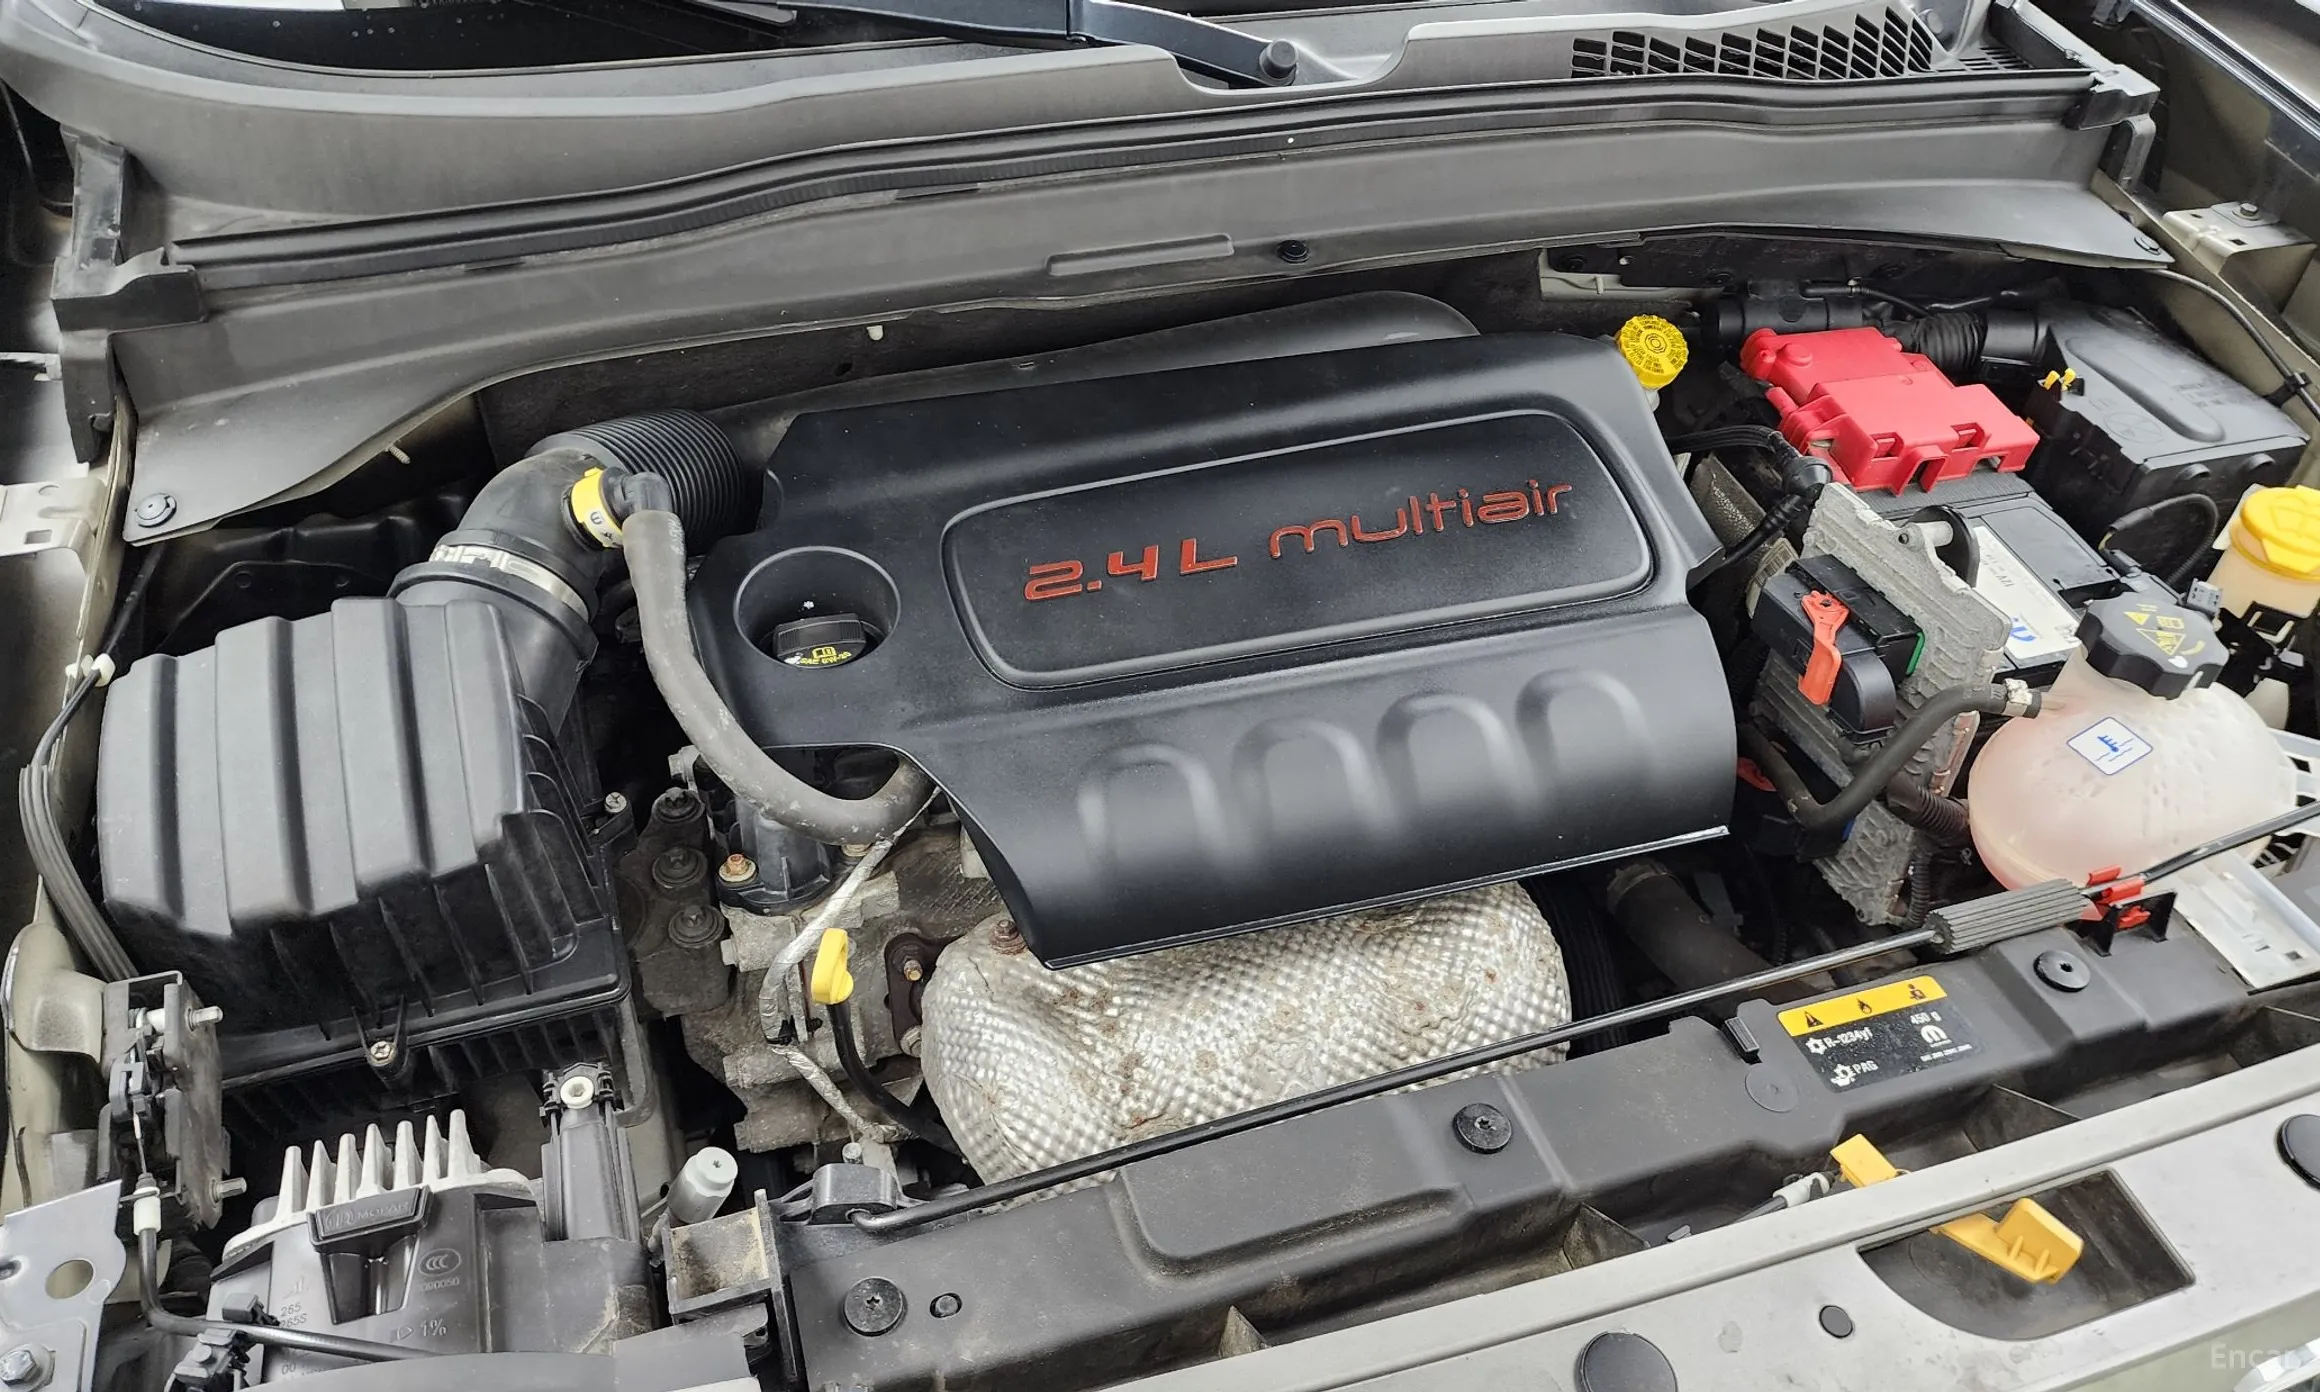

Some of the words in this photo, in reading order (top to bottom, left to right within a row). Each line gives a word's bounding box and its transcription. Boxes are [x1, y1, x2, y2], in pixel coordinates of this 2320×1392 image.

[1023, 545, 1159, 602] 2.4
[1179, 538, 1238, 576] L
[1269, 479, 1573, 560] multiair
[1824, 1027, 1873, 1048] R-1234yf
[1852, 1059, 1879, 1075] PAG
